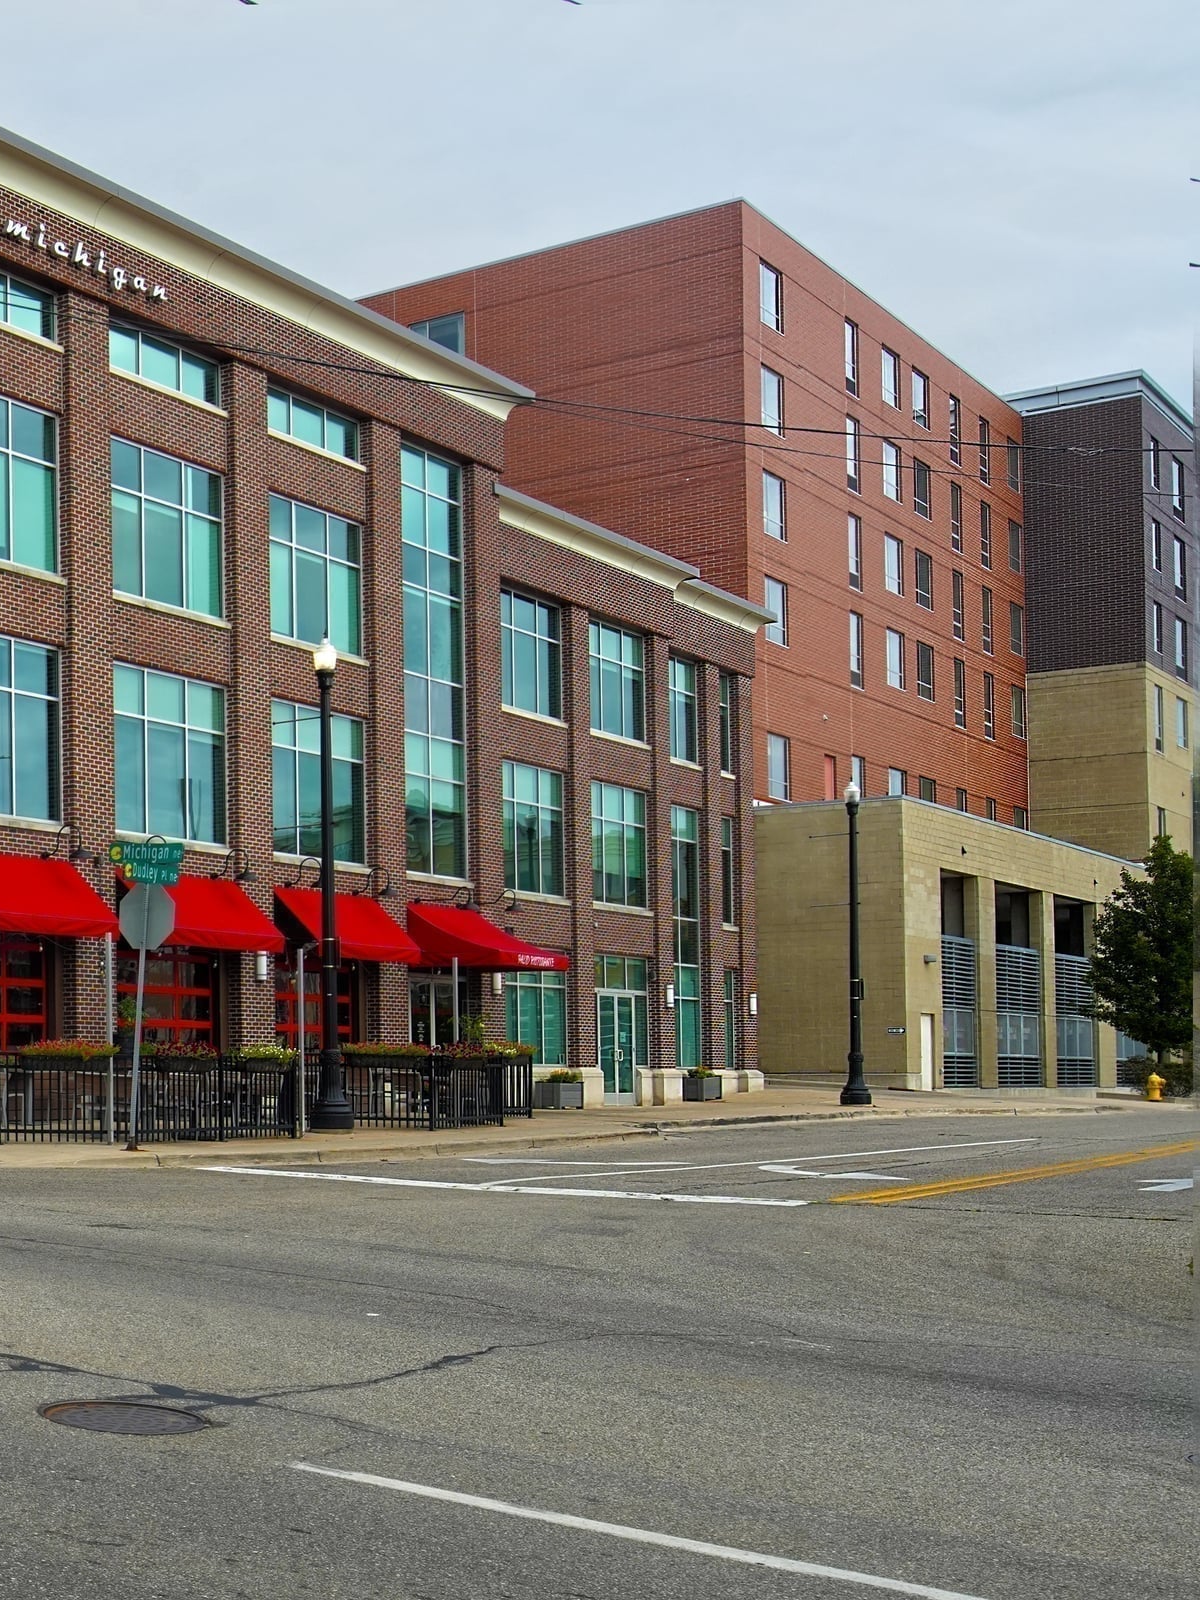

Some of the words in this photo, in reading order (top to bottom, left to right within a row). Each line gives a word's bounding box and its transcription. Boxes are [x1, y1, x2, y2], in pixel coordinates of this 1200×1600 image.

[3, 217, 169, 301] michigan
[123, 844, 169, 863] Michigan
[132, 862, 159, 884] Dudley
